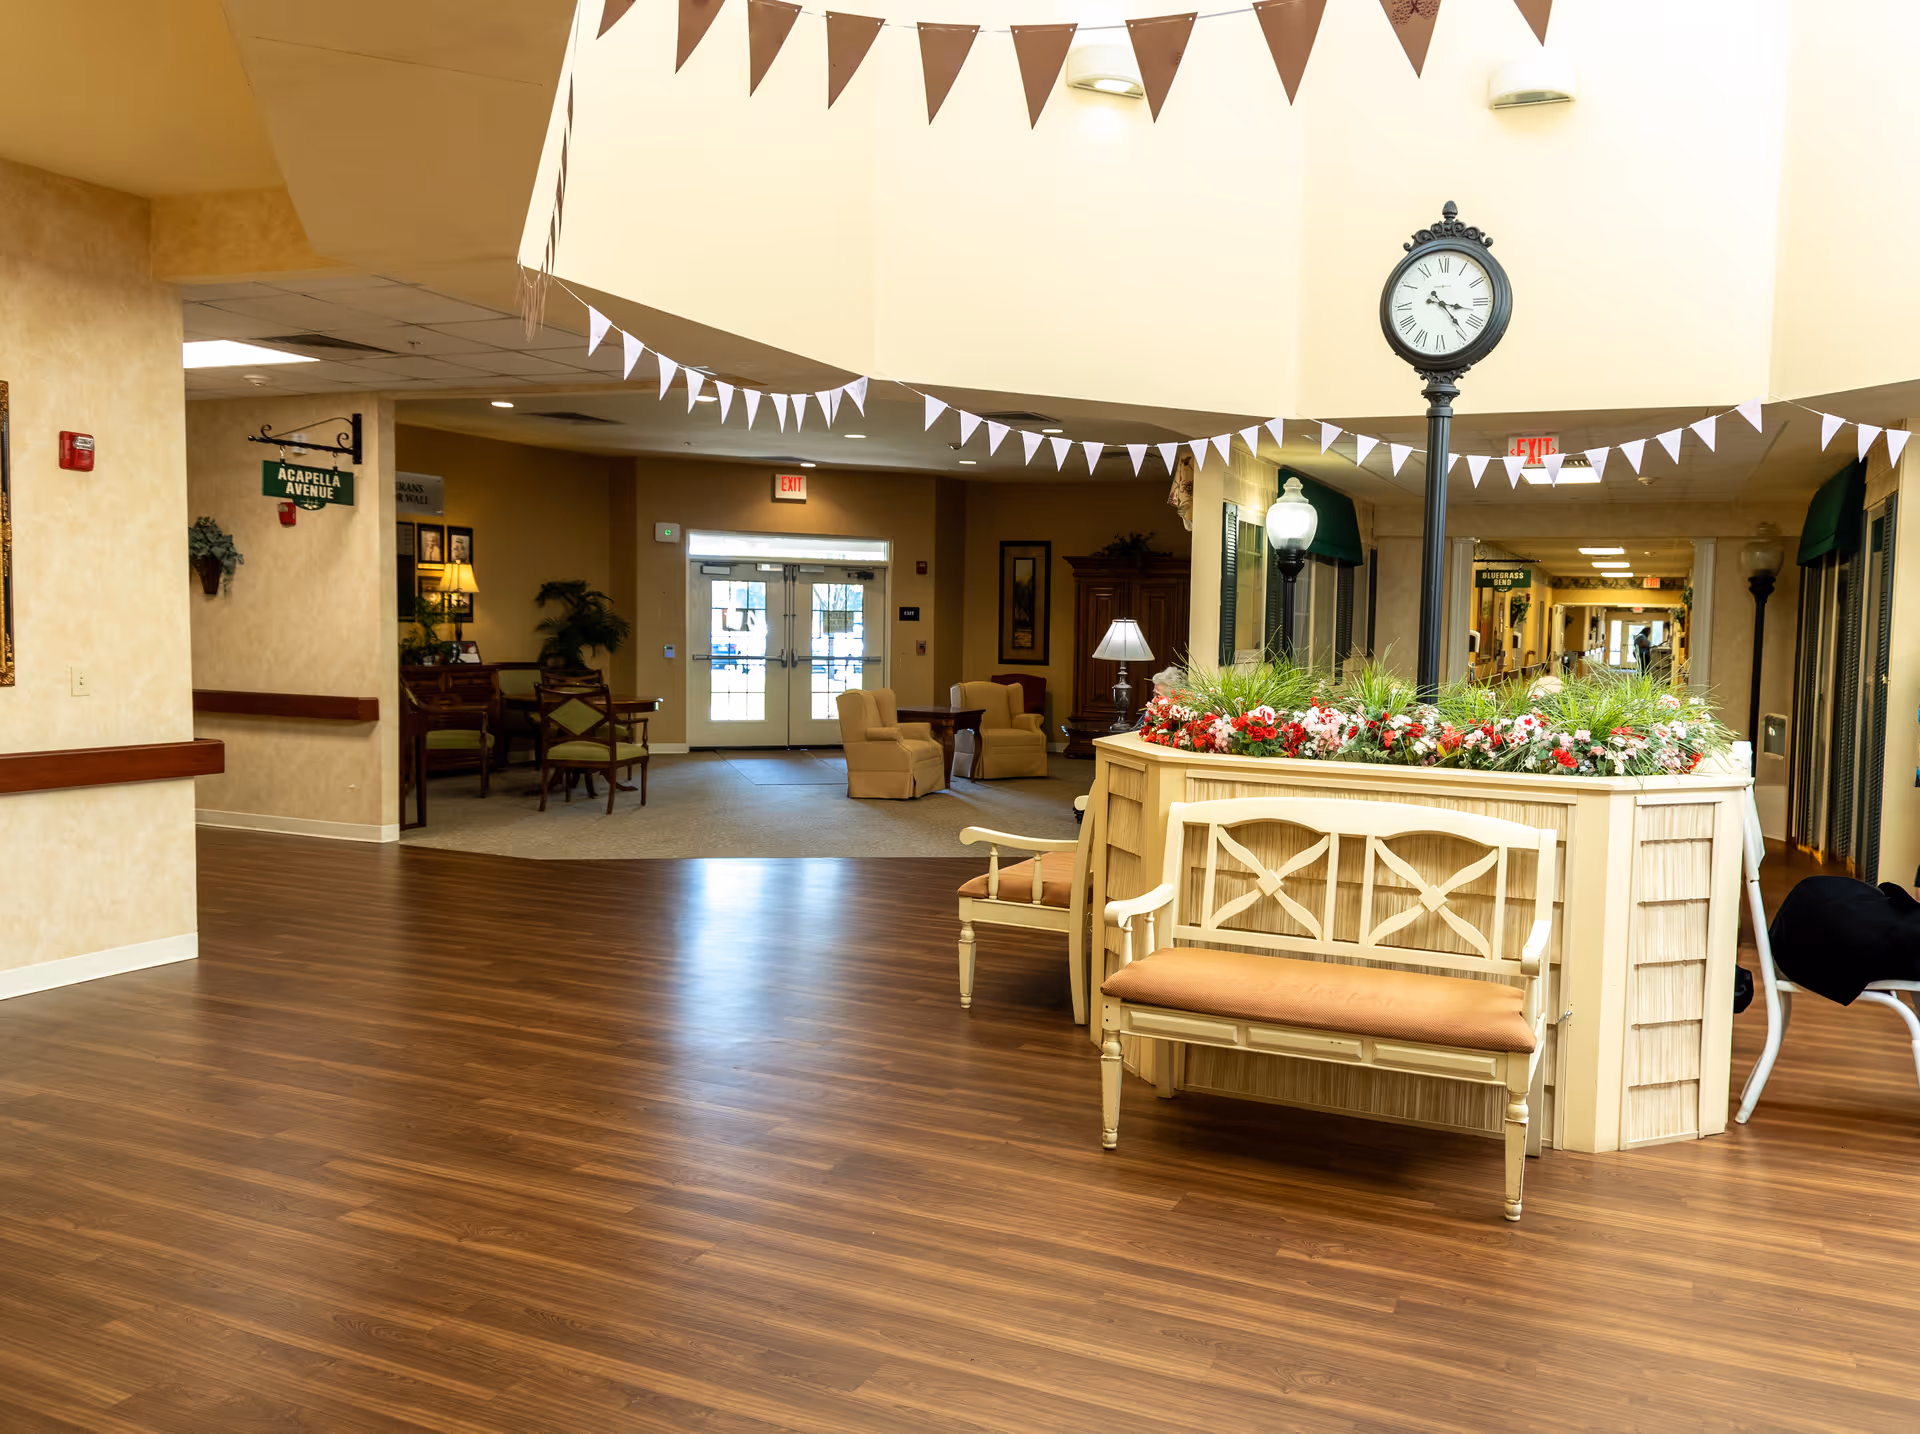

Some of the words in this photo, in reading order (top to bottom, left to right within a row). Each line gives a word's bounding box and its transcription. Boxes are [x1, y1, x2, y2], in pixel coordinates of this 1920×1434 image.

[1517, 437, 1553, 464] EXIT
[277, 467, 341, 488] ACAPELLA
[781, 475, 803, 492] EXIT
[285, 482, 335, 499] AVENUE
[1482, 571, 1524, 579] BLUEGRASS
